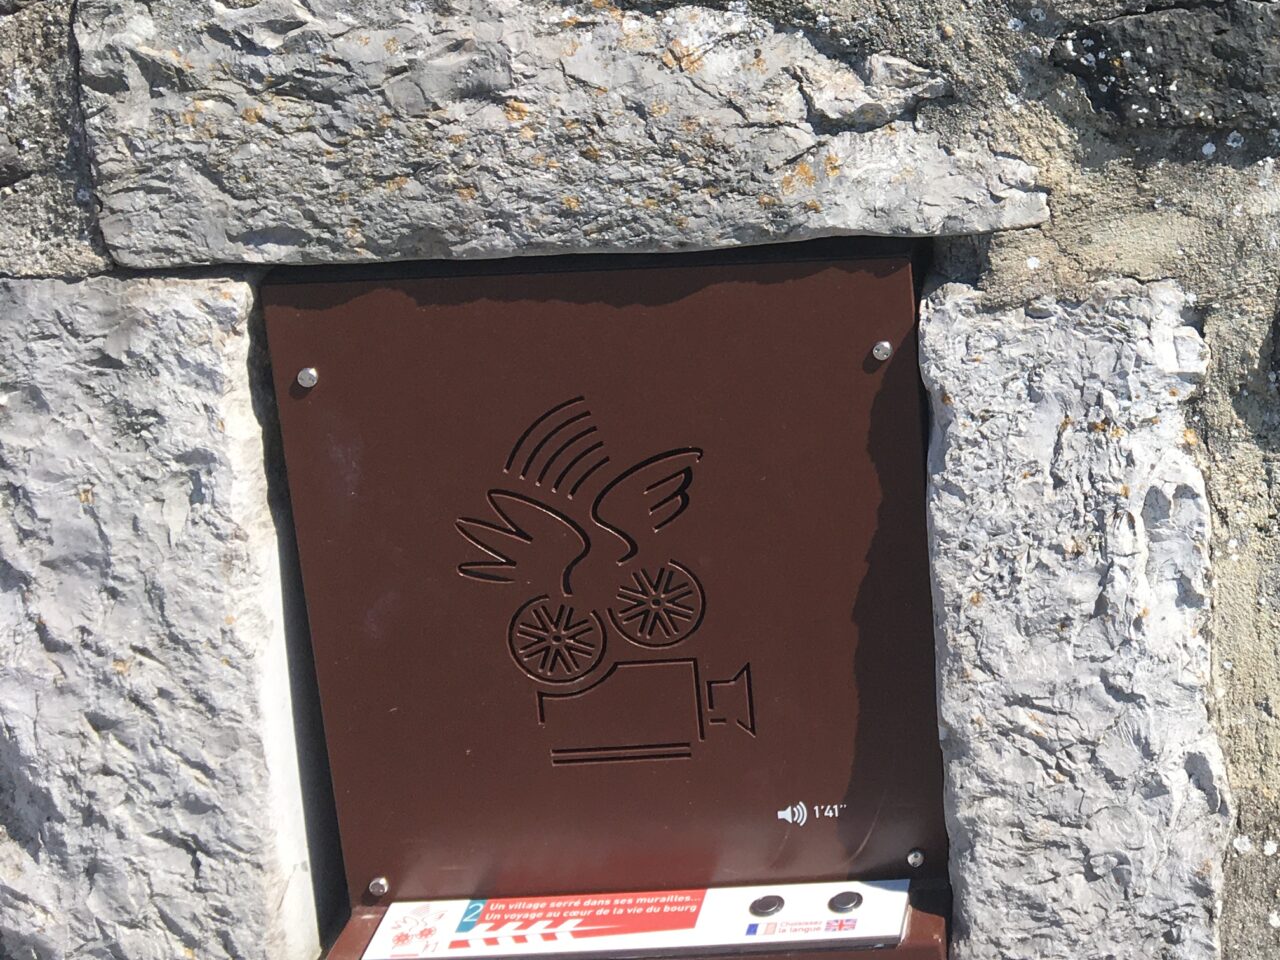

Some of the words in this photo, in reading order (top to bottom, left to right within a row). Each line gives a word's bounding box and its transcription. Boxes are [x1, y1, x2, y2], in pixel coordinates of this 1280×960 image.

[489, 902, 506, 911] Un
[508, 900, 547, 911] village
[549, 898, 581, 908] serré
[583, 898, 611, 907] dans
[613, 897, 633, 905] ses
[462, 902, 484, 923] 2
[485, 912, 501, 921] Un
[503, 911, 544, 921] voyage
[546, 910, 560, 918] au
[595, 907, 610, 916] de
[612, 907, 624, 915] la
[626, 906, 643, 914] vie
[645, 905, 661, 913] du
[663, 904, 698, 913] bourg
[789, 926, 822, 934] langue
